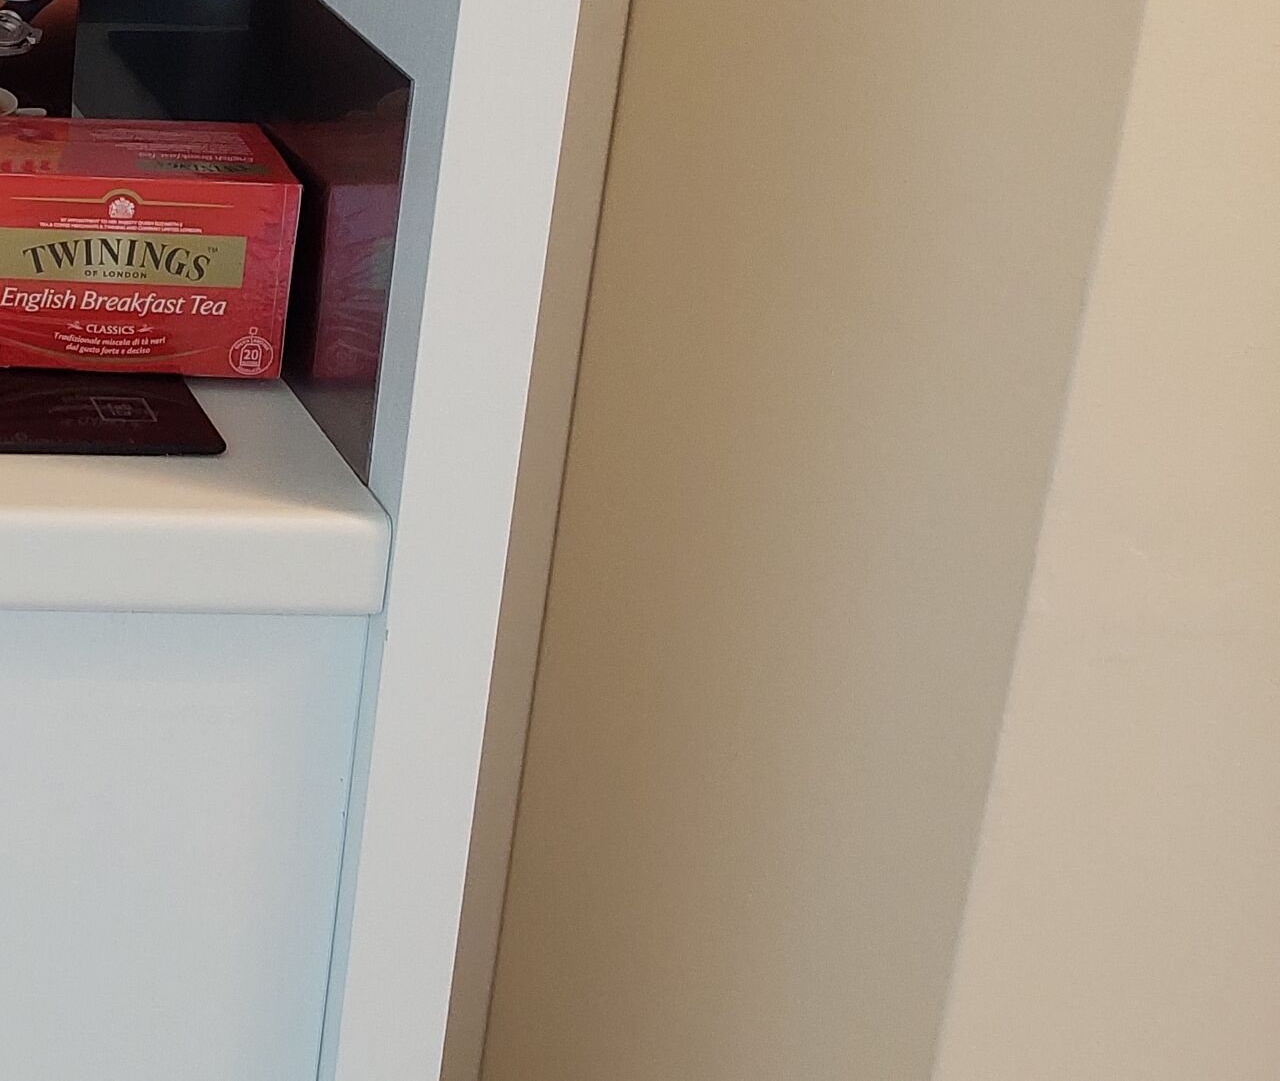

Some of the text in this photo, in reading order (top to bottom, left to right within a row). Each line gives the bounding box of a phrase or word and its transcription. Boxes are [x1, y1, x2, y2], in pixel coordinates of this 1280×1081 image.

[22, 237, 211, 282] TWININGS
[84, 269, 147, 279] OF LONDON
[0, 287, 227, 317] English Breakfast Tea
[85, 323, 135, 335] CLASSICS
[131, 338, 140, 346] di
[78, 344, 100, 355] gusto
[126, 346, 151, 354] deciso
[243, 349, 259, 361] 20
